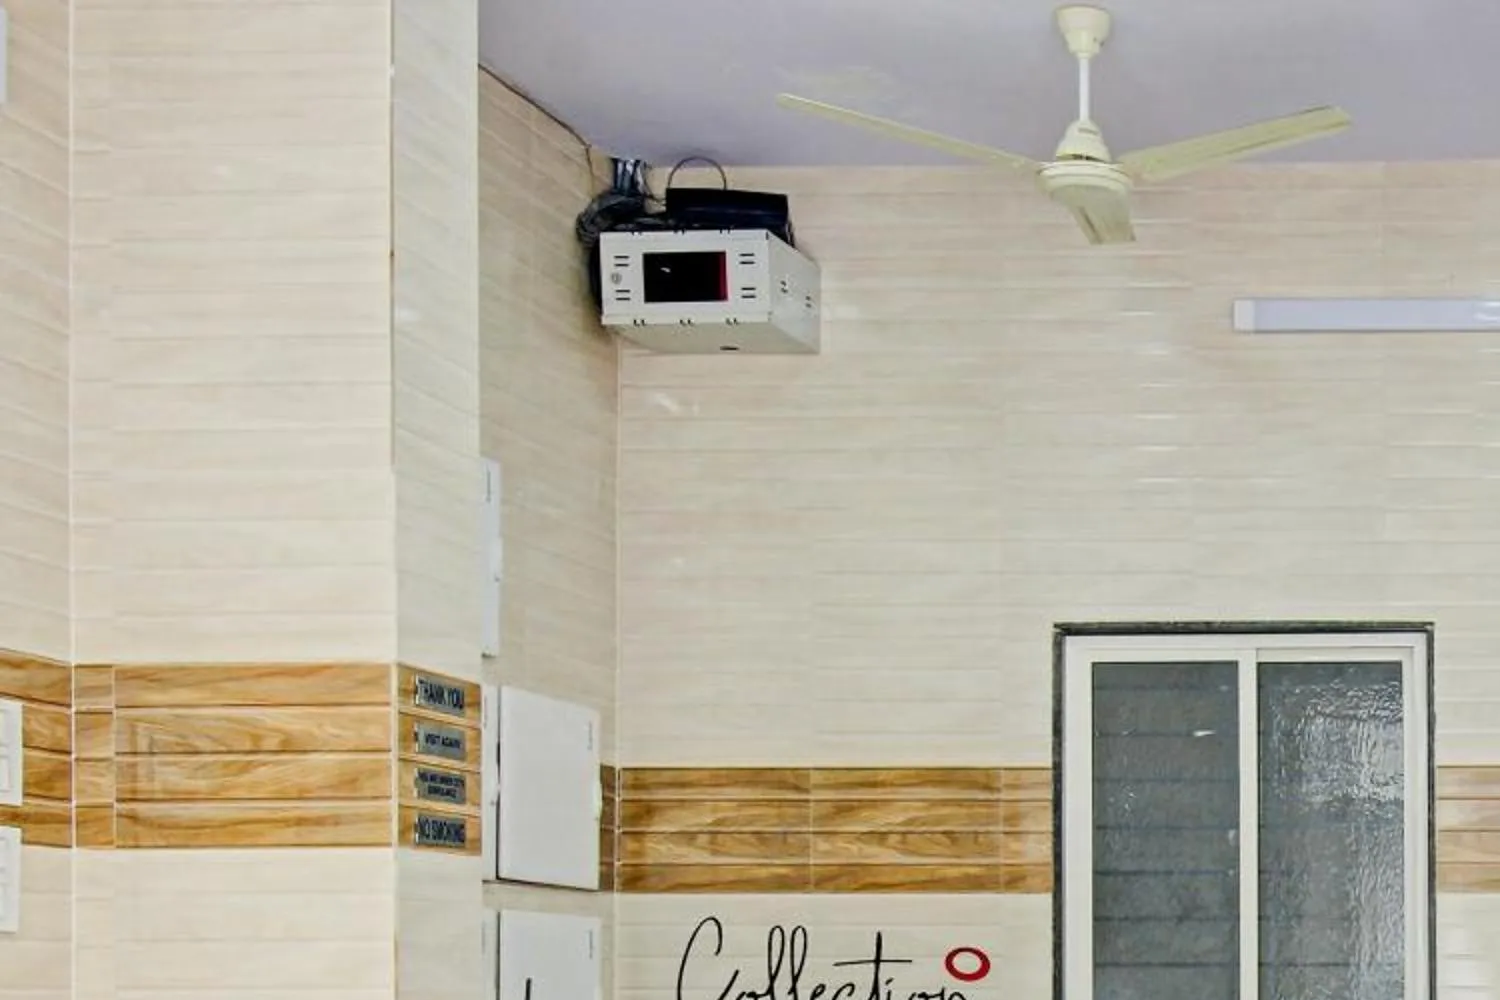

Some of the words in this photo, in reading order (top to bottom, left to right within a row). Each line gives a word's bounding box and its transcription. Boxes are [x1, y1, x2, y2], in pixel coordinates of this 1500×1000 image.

[418, 677, 446, 706] THANK
[446, 686, 465, 710] YOU
[418, 815, 431, 839] NO
